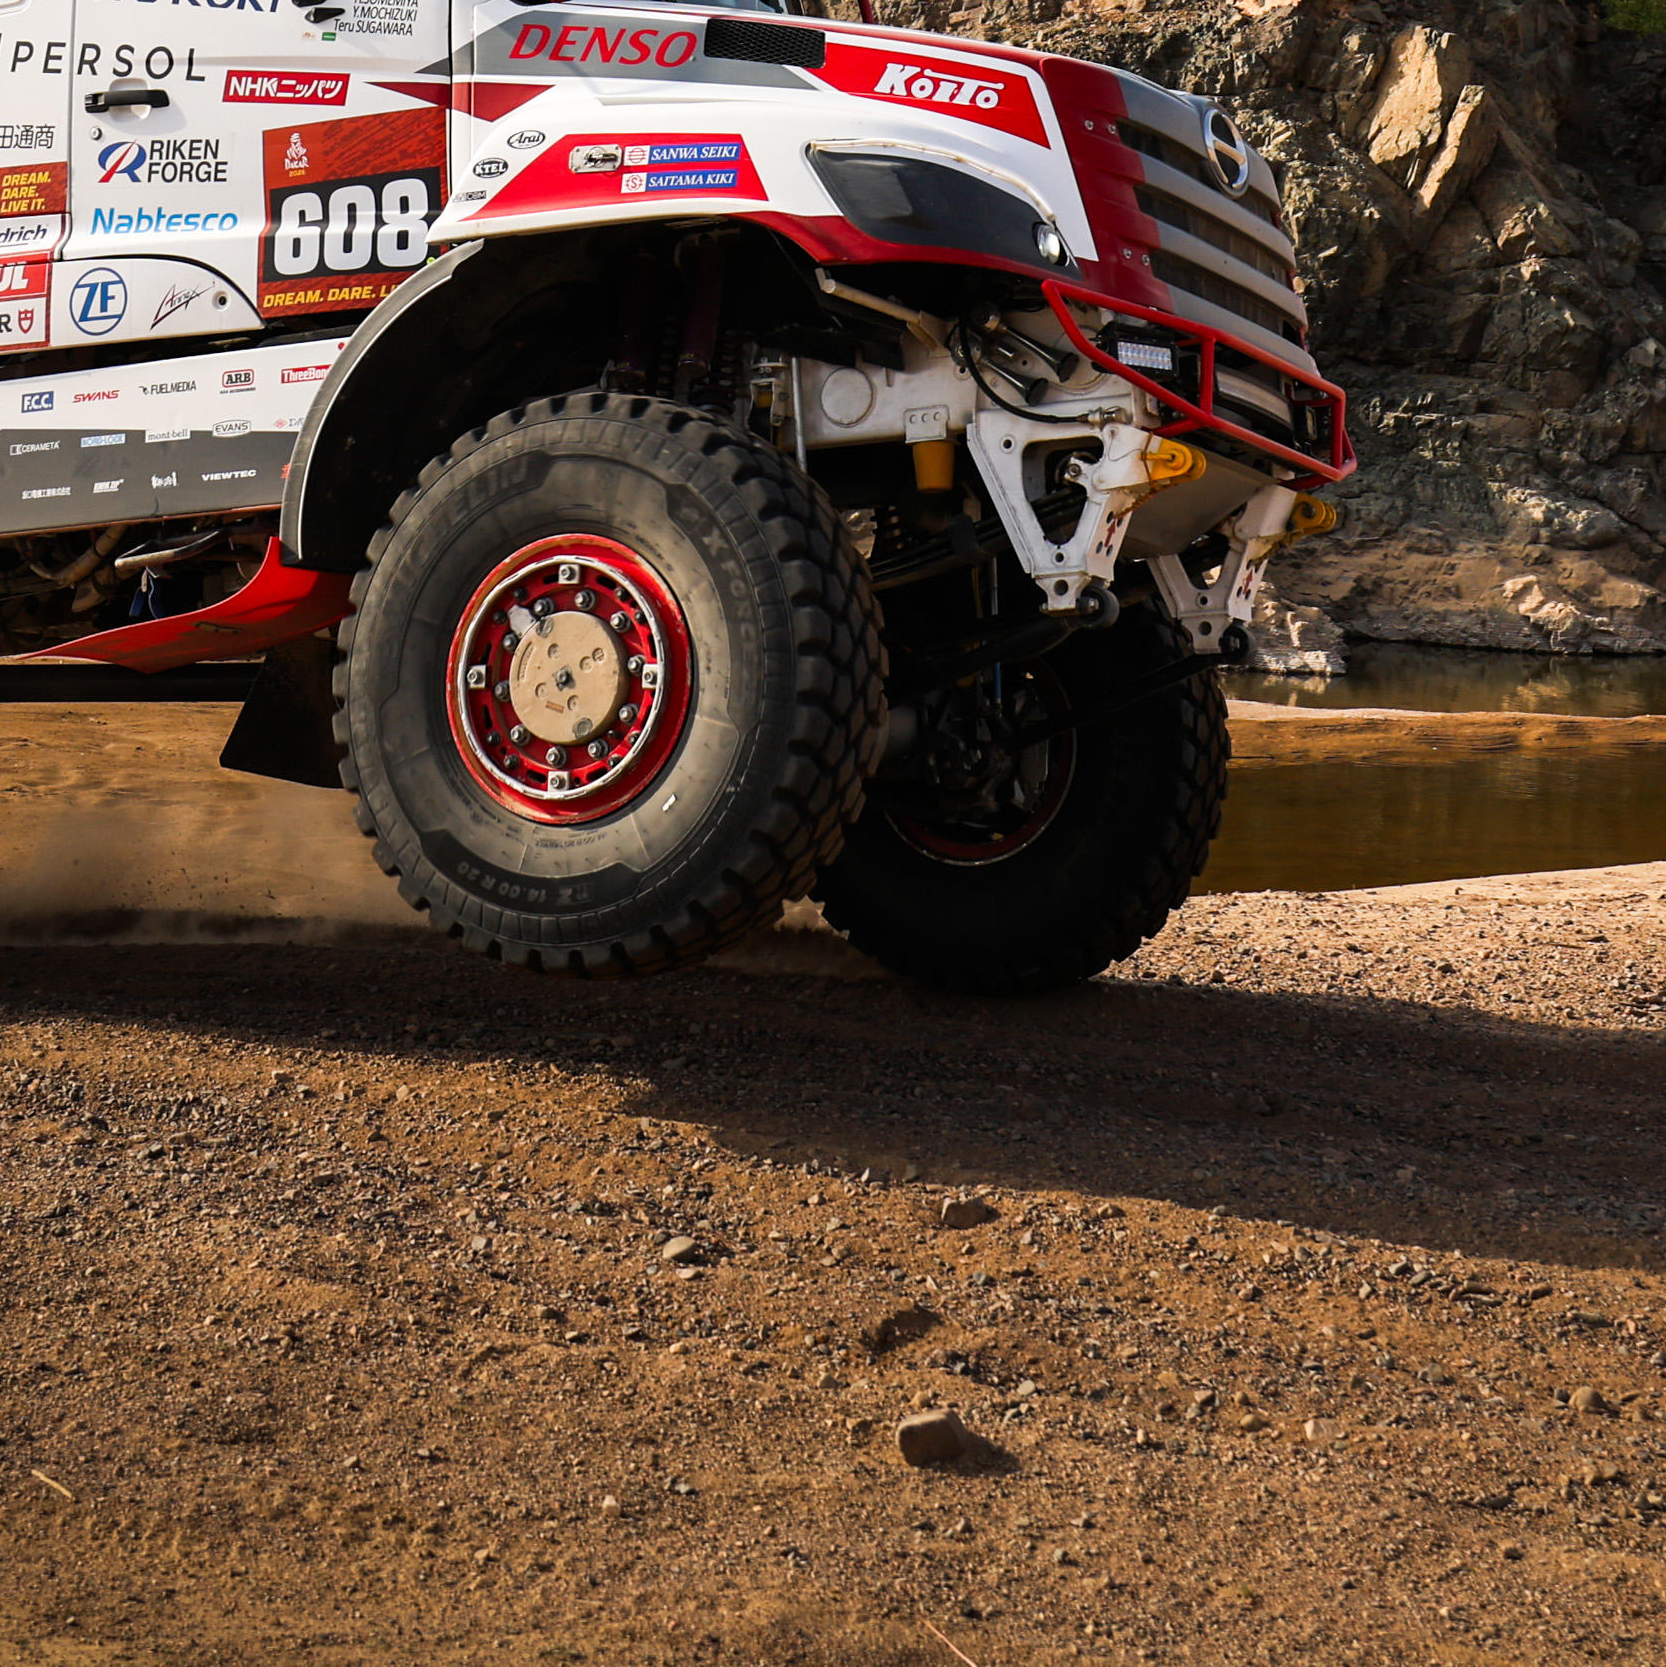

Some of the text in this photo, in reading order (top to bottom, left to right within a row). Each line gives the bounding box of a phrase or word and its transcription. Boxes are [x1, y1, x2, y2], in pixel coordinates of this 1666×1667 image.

[353, 5, 417, 22] Y.MOCHIZUKI
[334, 18, 413, 36] Teru SUGAWARA
[508, 23, 698, 68] DENSO
[11, 40, 206, 82] PERSOL
[510, 132, 543, 146] Arai
[149, 139, 220, 160] RIKEN
[651, 145, 738, 161] SANWA SEIKI
[147, 161, 228, 183] FORGE
[475, 160, 507, 176] KTEL
[1, 171, 51, 187] DREAM.
[649, 173, 735, 189] SAITAMA KIKI
[1, 186, 39, 200] DARE.
[0, 198, 46, 213] LIVE IT.
[90, 206, 239, 235] Nabtesco
[274, 178, 429, 276] 608
[75, 279, 124, 323] ZF
[263, 286, 376, 308] DREAM. DARE.
[225, 371, 251, 385] ARB
[151, 380, 196, 395] FUELMEDIA
[23, 393, 52, 412] F.C.C.
[73, 390, 120, 403] SWANS
[215, 421, 248, 433] EVANS
[201, 469, 257, 481] VIEWTEC
